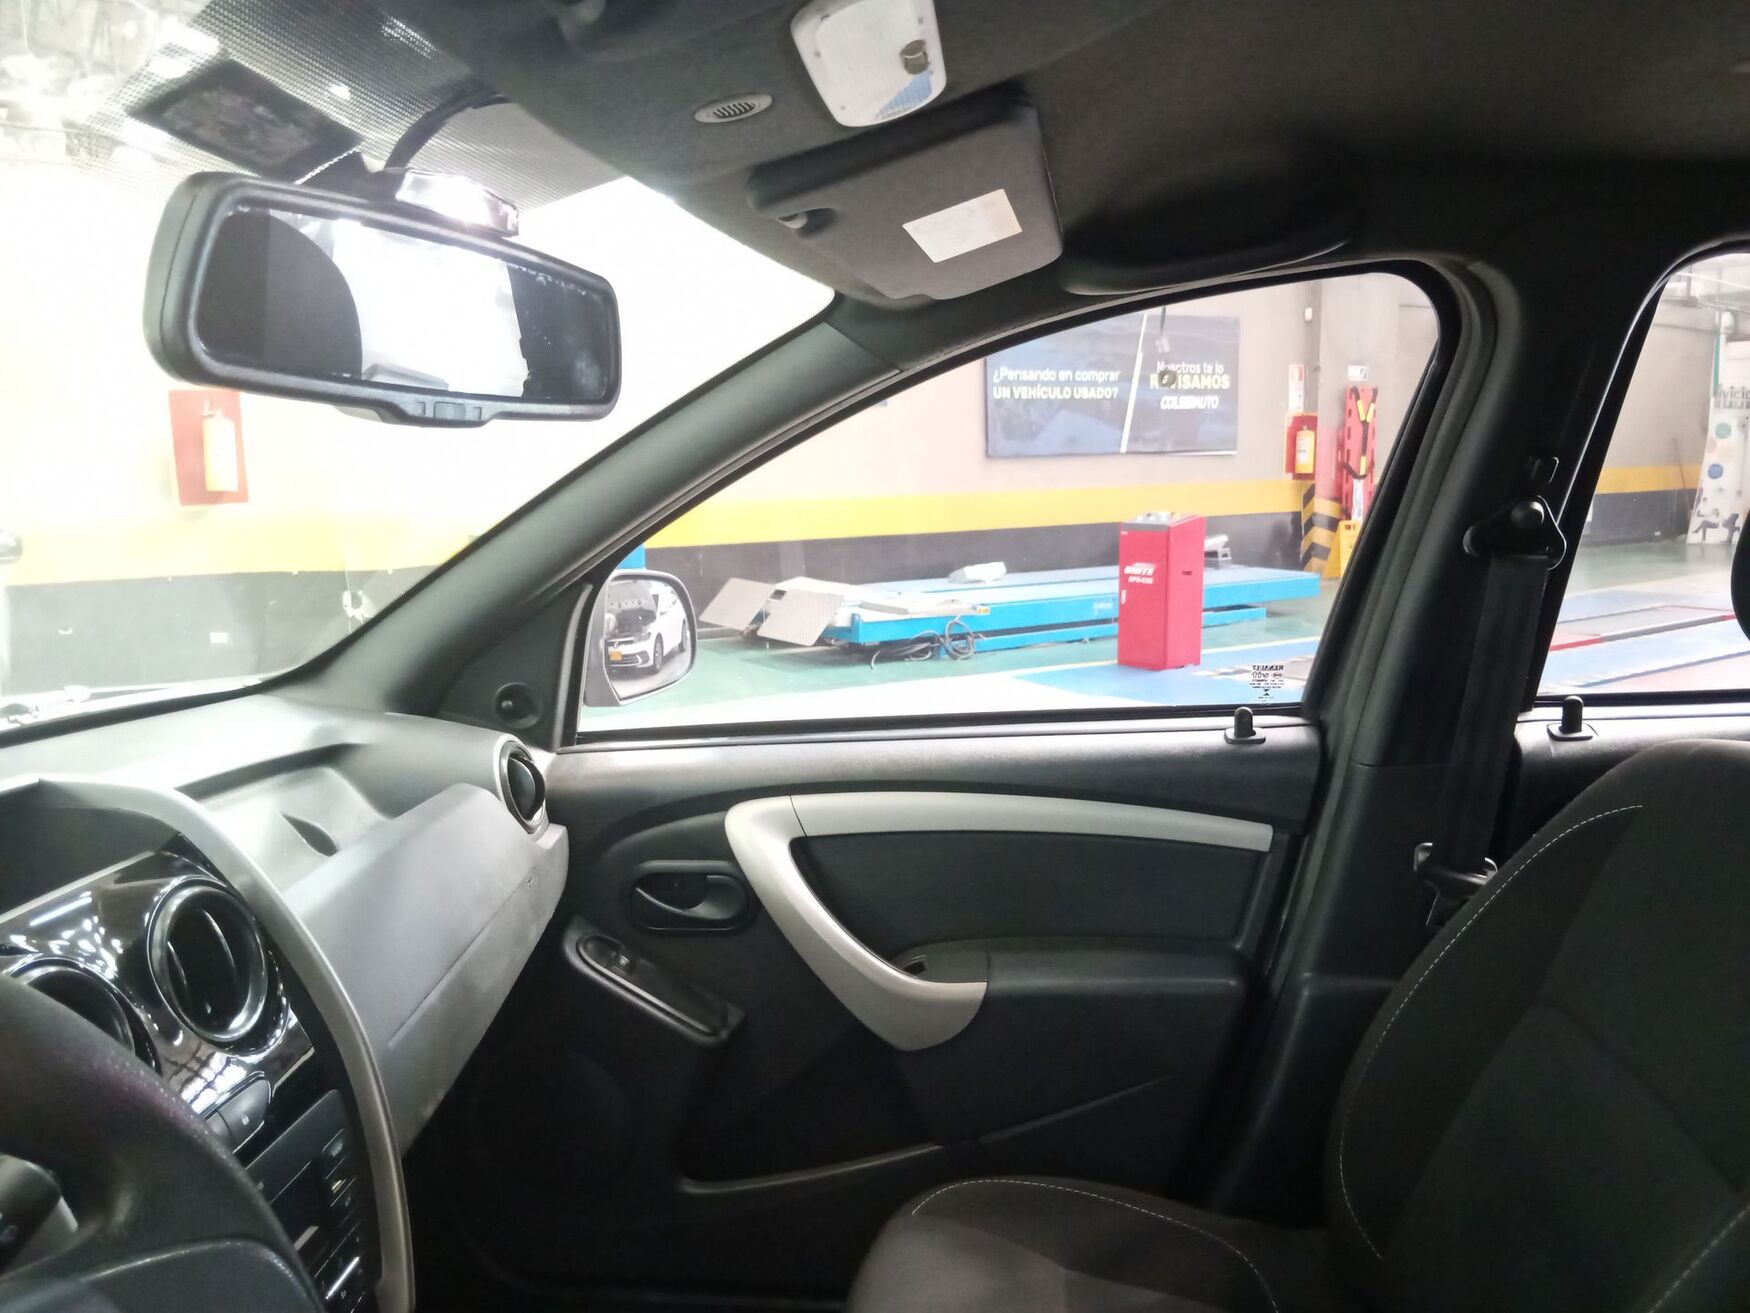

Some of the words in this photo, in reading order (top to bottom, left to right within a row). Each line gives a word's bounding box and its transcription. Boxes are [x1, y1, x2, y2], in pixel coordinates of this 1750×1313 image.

[993, 367, 1056, 383] ¿Pensando
[1059, 369, 1073, 381] en
[1075, 370, 1119, 383] comprar
[1215, 362, 1224, 374] lo
[1149, 373, 1231, 390] RISAMOS
[993, 385, 1010, 400] UN
[1012, 384, 1072, 400] VEHÍCULO
[1073, 387, 1119, 400] USADO?
